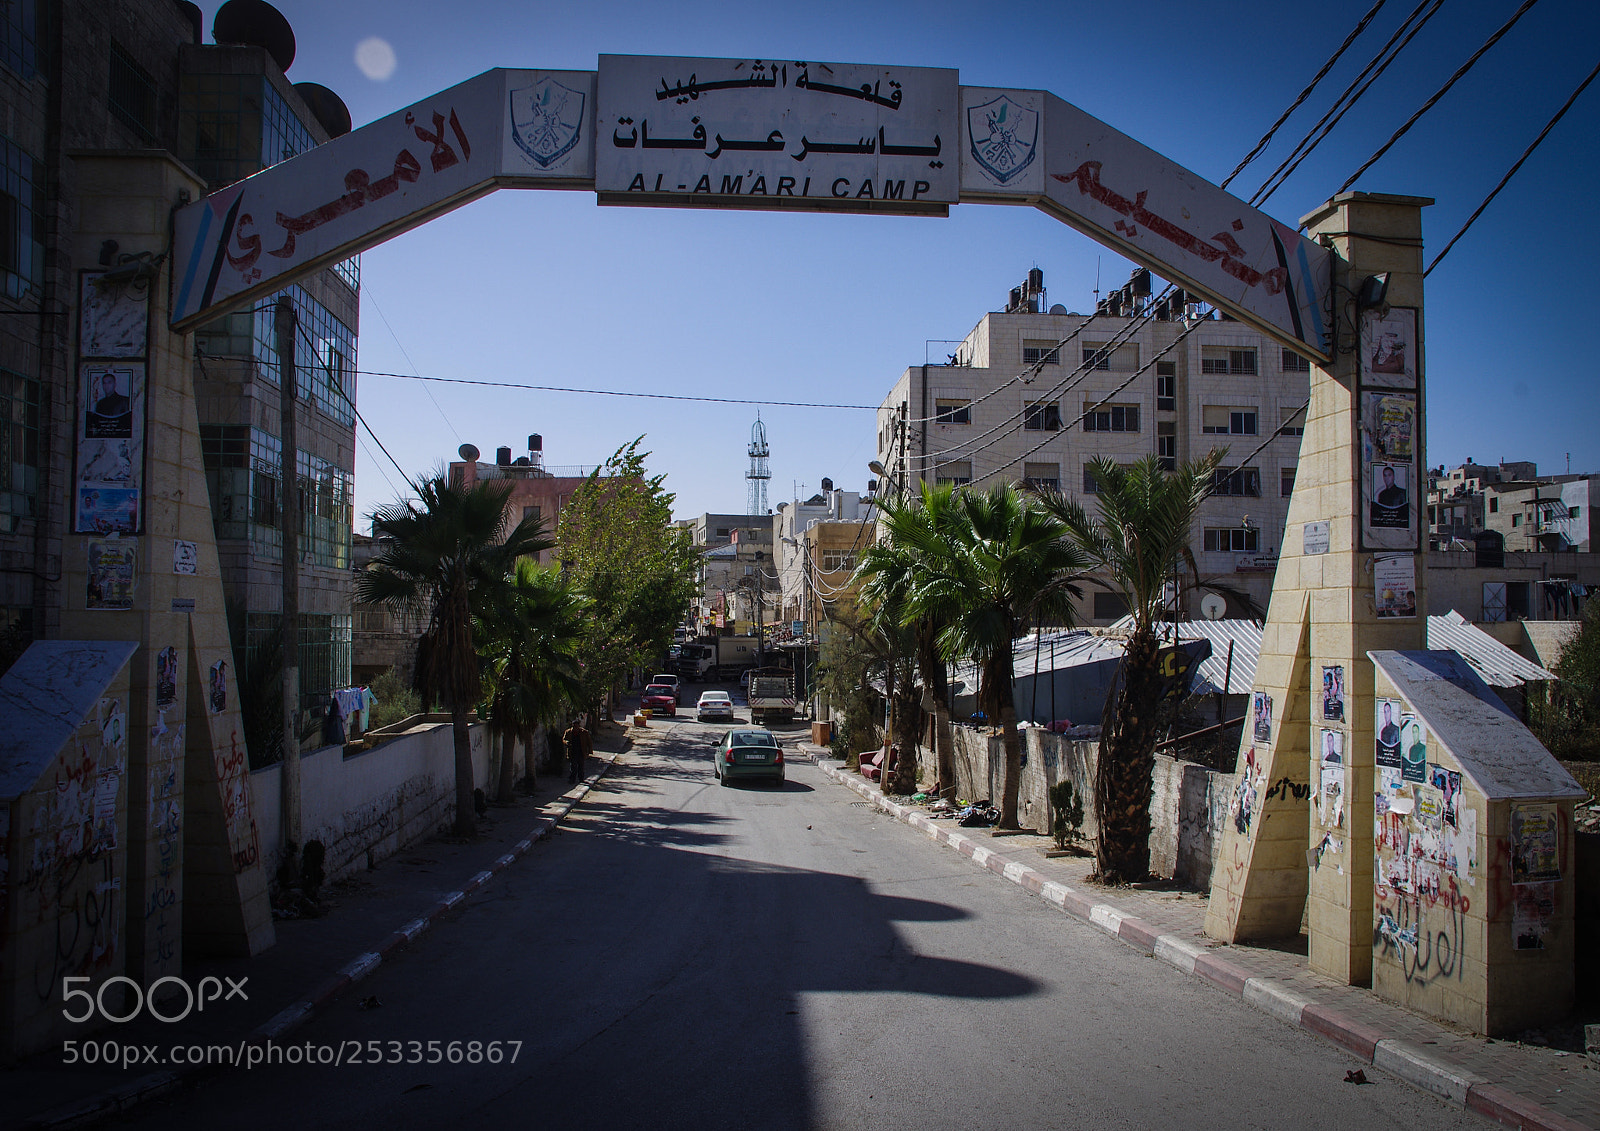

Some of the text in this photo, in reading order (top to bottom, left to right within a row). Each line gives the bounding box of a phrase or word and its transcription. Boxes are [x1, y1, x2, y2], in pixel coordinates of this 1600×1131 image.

[655, 59, 902, 110] قلعة الشهيد
[613, 115, 786, 160] عرفات
[791, 126, 944, 170] ياسر
[225, 107, 1288, 296] مخيم الأمعري
[628, 169, 931, 201] AL-AM'ARI CAMP
